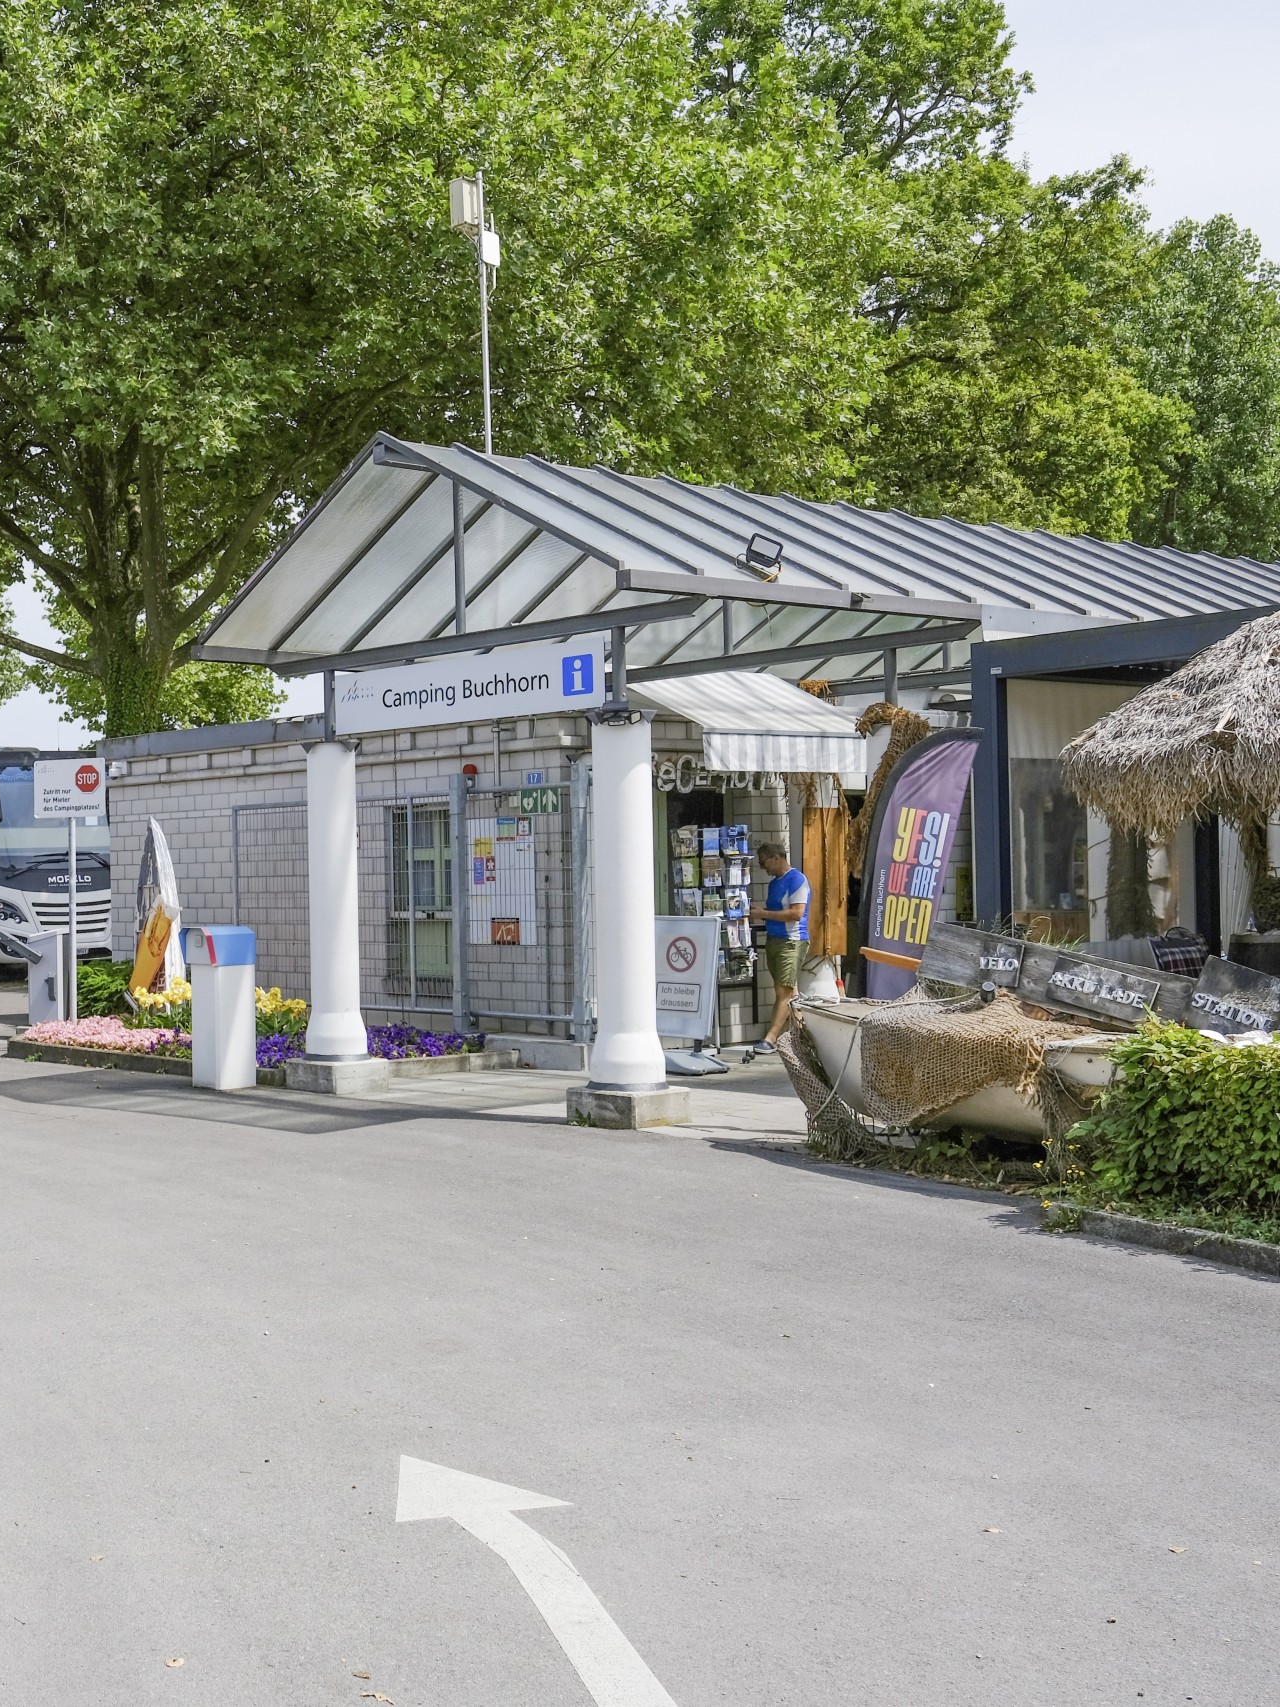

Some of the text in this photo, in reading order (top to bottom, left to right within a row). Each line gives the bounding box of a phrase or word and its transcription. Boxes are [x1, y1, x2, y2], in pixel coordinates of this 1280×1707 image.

[382, 682, 456, 710] Camping
[462, 672, 550, 699] Buchhorn
[77, 772, 97, 785] STOP
[54, 803, 100, 812] Campingplatzes!
[892, 806, 951, 868] YES!
[888, 862, 940, 899] WE ARE
[874, 869, 887, 937] Camping Buchhorn
[883, 894, 933, 946] OPEN
[978, 956, 1019, 971] VELO
[660, 999, 694, 1008] draussen
[661, 986, 695, 996] Ich bleibe
[1048, 971, 1147, 1009] AKKU LADE
[1191, 992, 1273, 1031] STATION
